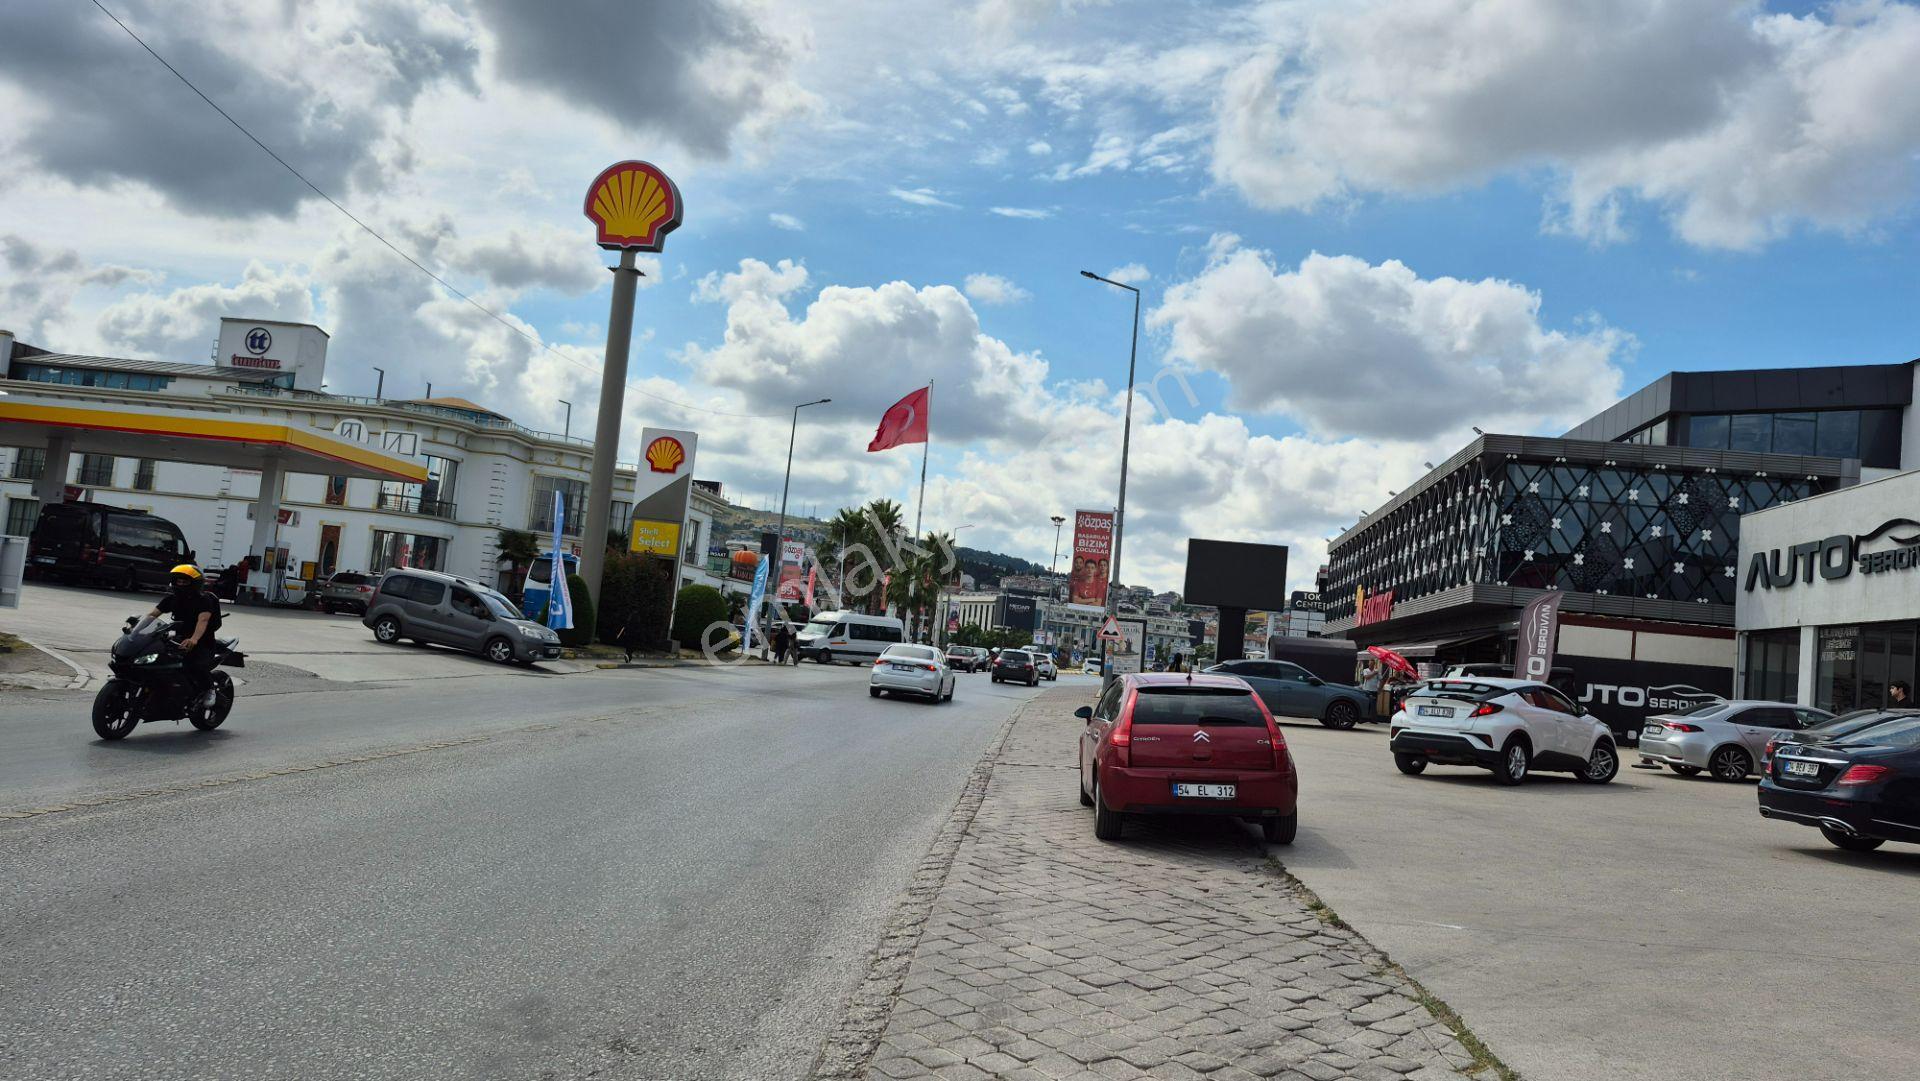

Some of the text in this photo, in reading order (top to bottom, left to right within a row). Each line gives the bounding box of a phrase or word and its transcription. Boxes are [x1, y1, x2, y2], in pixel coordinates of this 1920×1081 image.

[639, 527, 659, 535] Shell
[1085, 517, 1112, 533] özpaş
[638, 536, 671, 548] Select
[1744, 534, 1854, 592] AUTO
[1859, 545, 1920, 574] SERDİ
[1577, 683, 1645, 707] UTO
[1178, 785, 1234, 797] 54 EL 312
